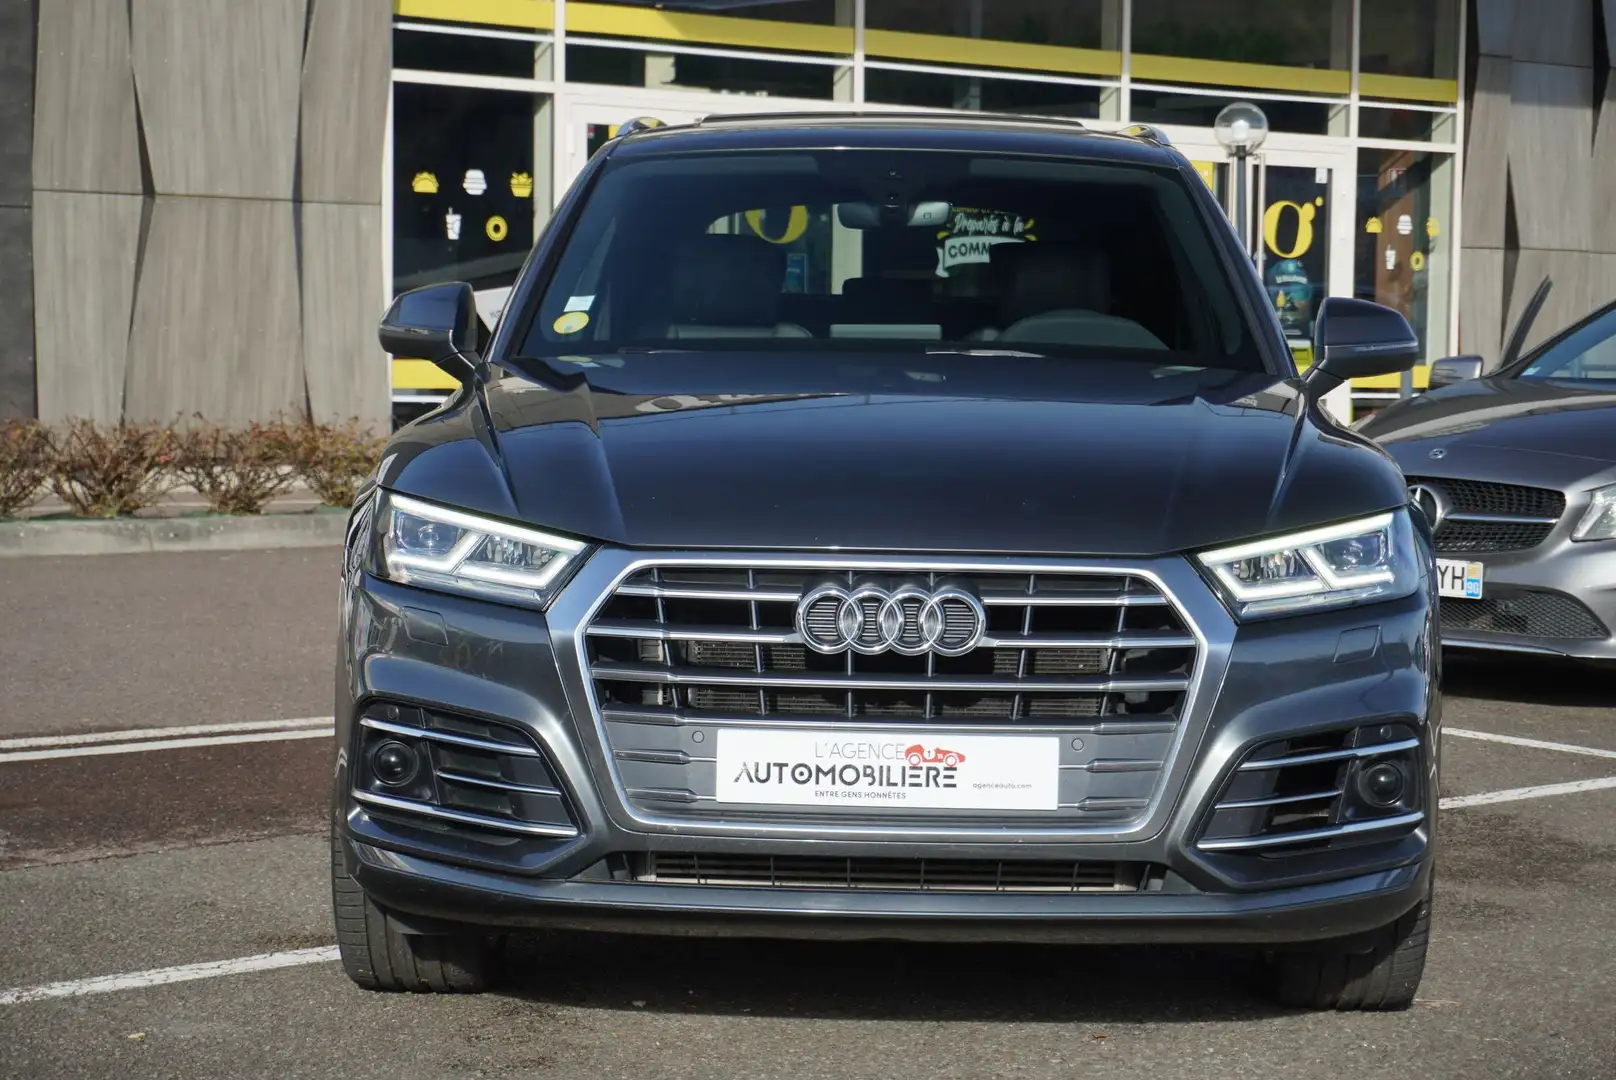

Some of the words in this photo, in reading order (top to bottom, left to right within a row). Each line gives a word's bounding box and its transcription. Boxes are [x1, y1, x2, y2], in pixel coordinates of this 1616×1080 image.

[814, 741, 906, 760] L'AGENCE
[972, 782, 1033, 790] agenceauto.com
[815, 790, 839, 798] ENTRE
[841, 791, 862, 799] GENS
